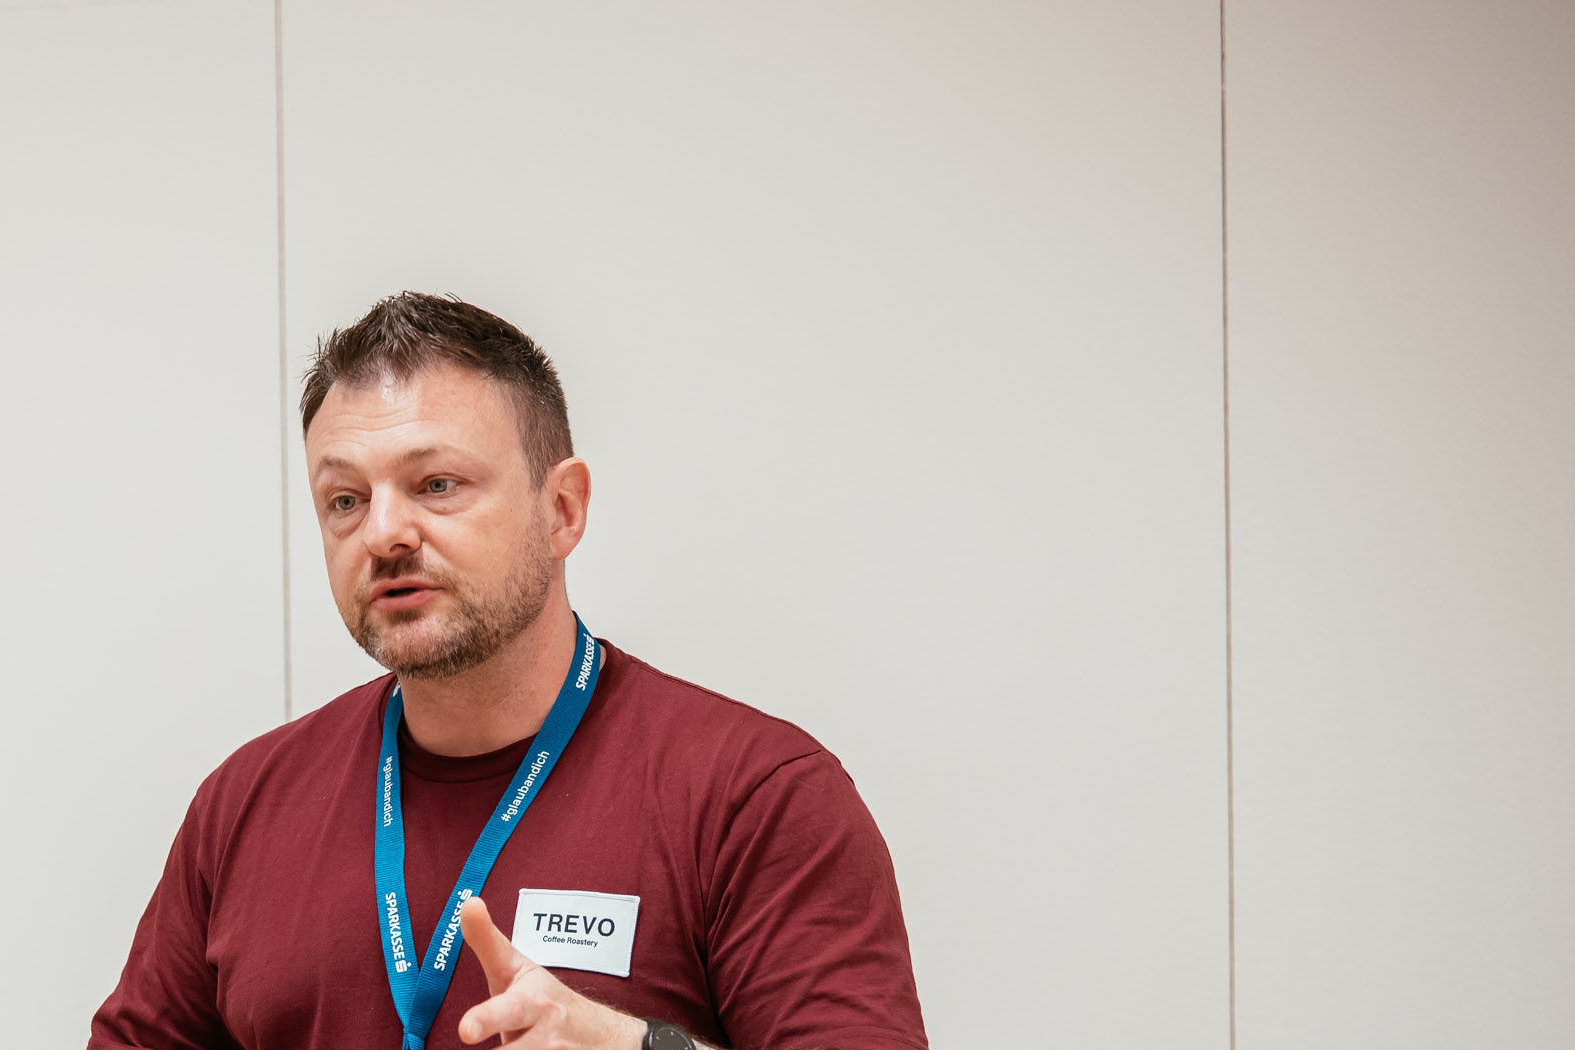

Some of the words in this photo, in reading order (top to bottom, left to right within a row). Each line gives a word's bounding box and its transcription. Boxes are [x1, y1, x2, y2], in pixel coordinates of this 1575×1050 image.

[576, 639, 595, 691] SPARKASSE
[383, 756, 393, 827] #glaubandich
[501, 750, 550, 822] #glaubandich
[385, 892, 406, 963] SPARKASSE
[534, 913, 615, 938] TREVO
[542, 935, 565, 944] Coffee
[567, 937, 599, 948] Roastery
